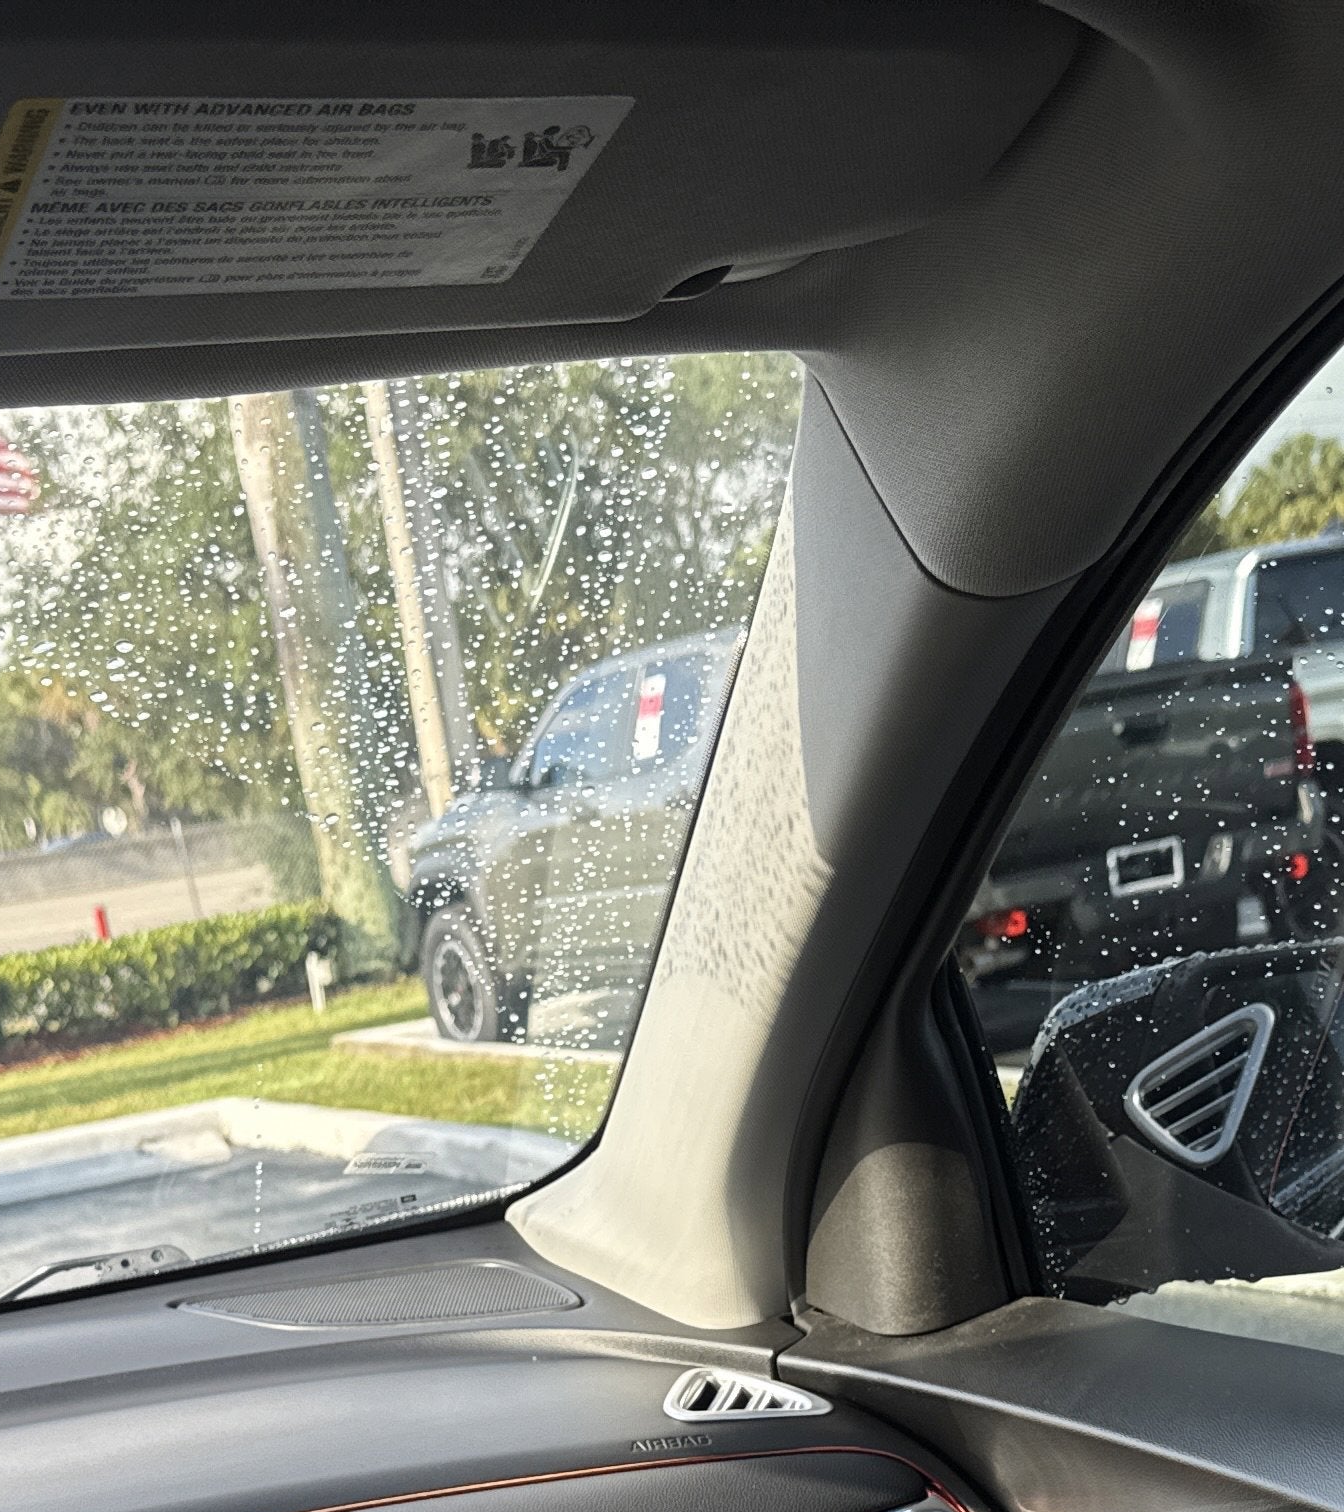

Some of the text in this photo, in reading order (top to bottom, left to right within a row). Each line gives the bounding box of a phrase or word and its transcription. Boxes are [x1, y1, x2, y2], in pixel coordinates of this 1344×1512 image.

[70, 103, 417, 116] EVEN WITH ADVANCED AIR BAGS
[30, 197, 494, 214] MÊME AVEC DES SACS GONFLABLES INTELLIGENTS
